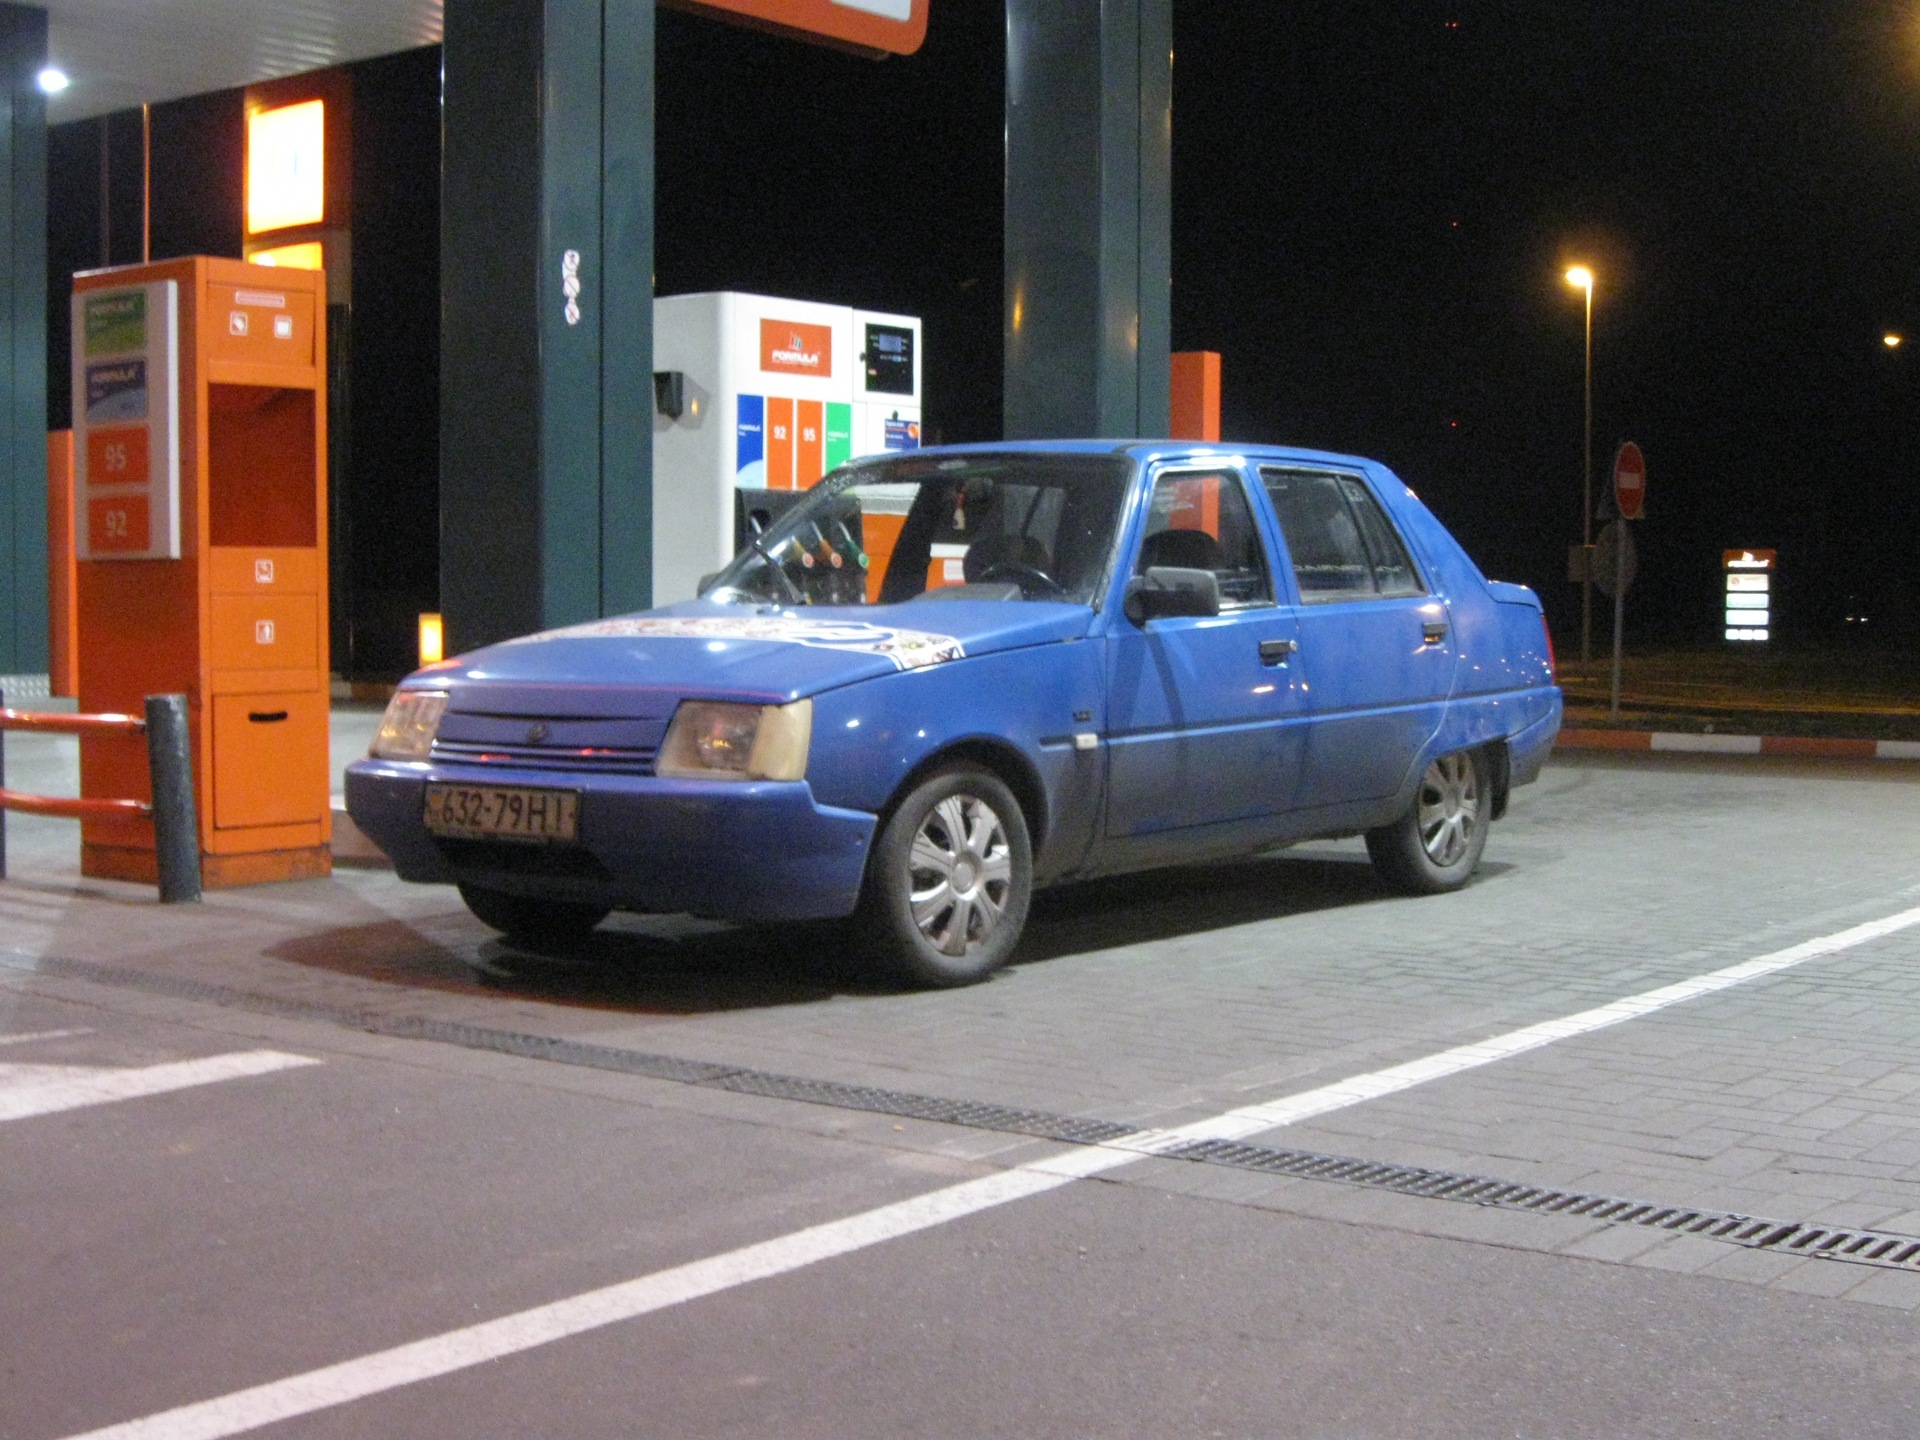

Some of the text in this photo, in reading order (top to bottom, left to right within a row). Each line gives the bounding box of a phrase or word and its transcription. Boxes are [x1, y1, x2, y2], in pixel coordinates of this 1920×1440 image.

[773, 425, 786, 440] 92
[803, 427, 816, 442] 95
[105, 443, 127, 472] 95
[106, 509, 128, 537] 92
